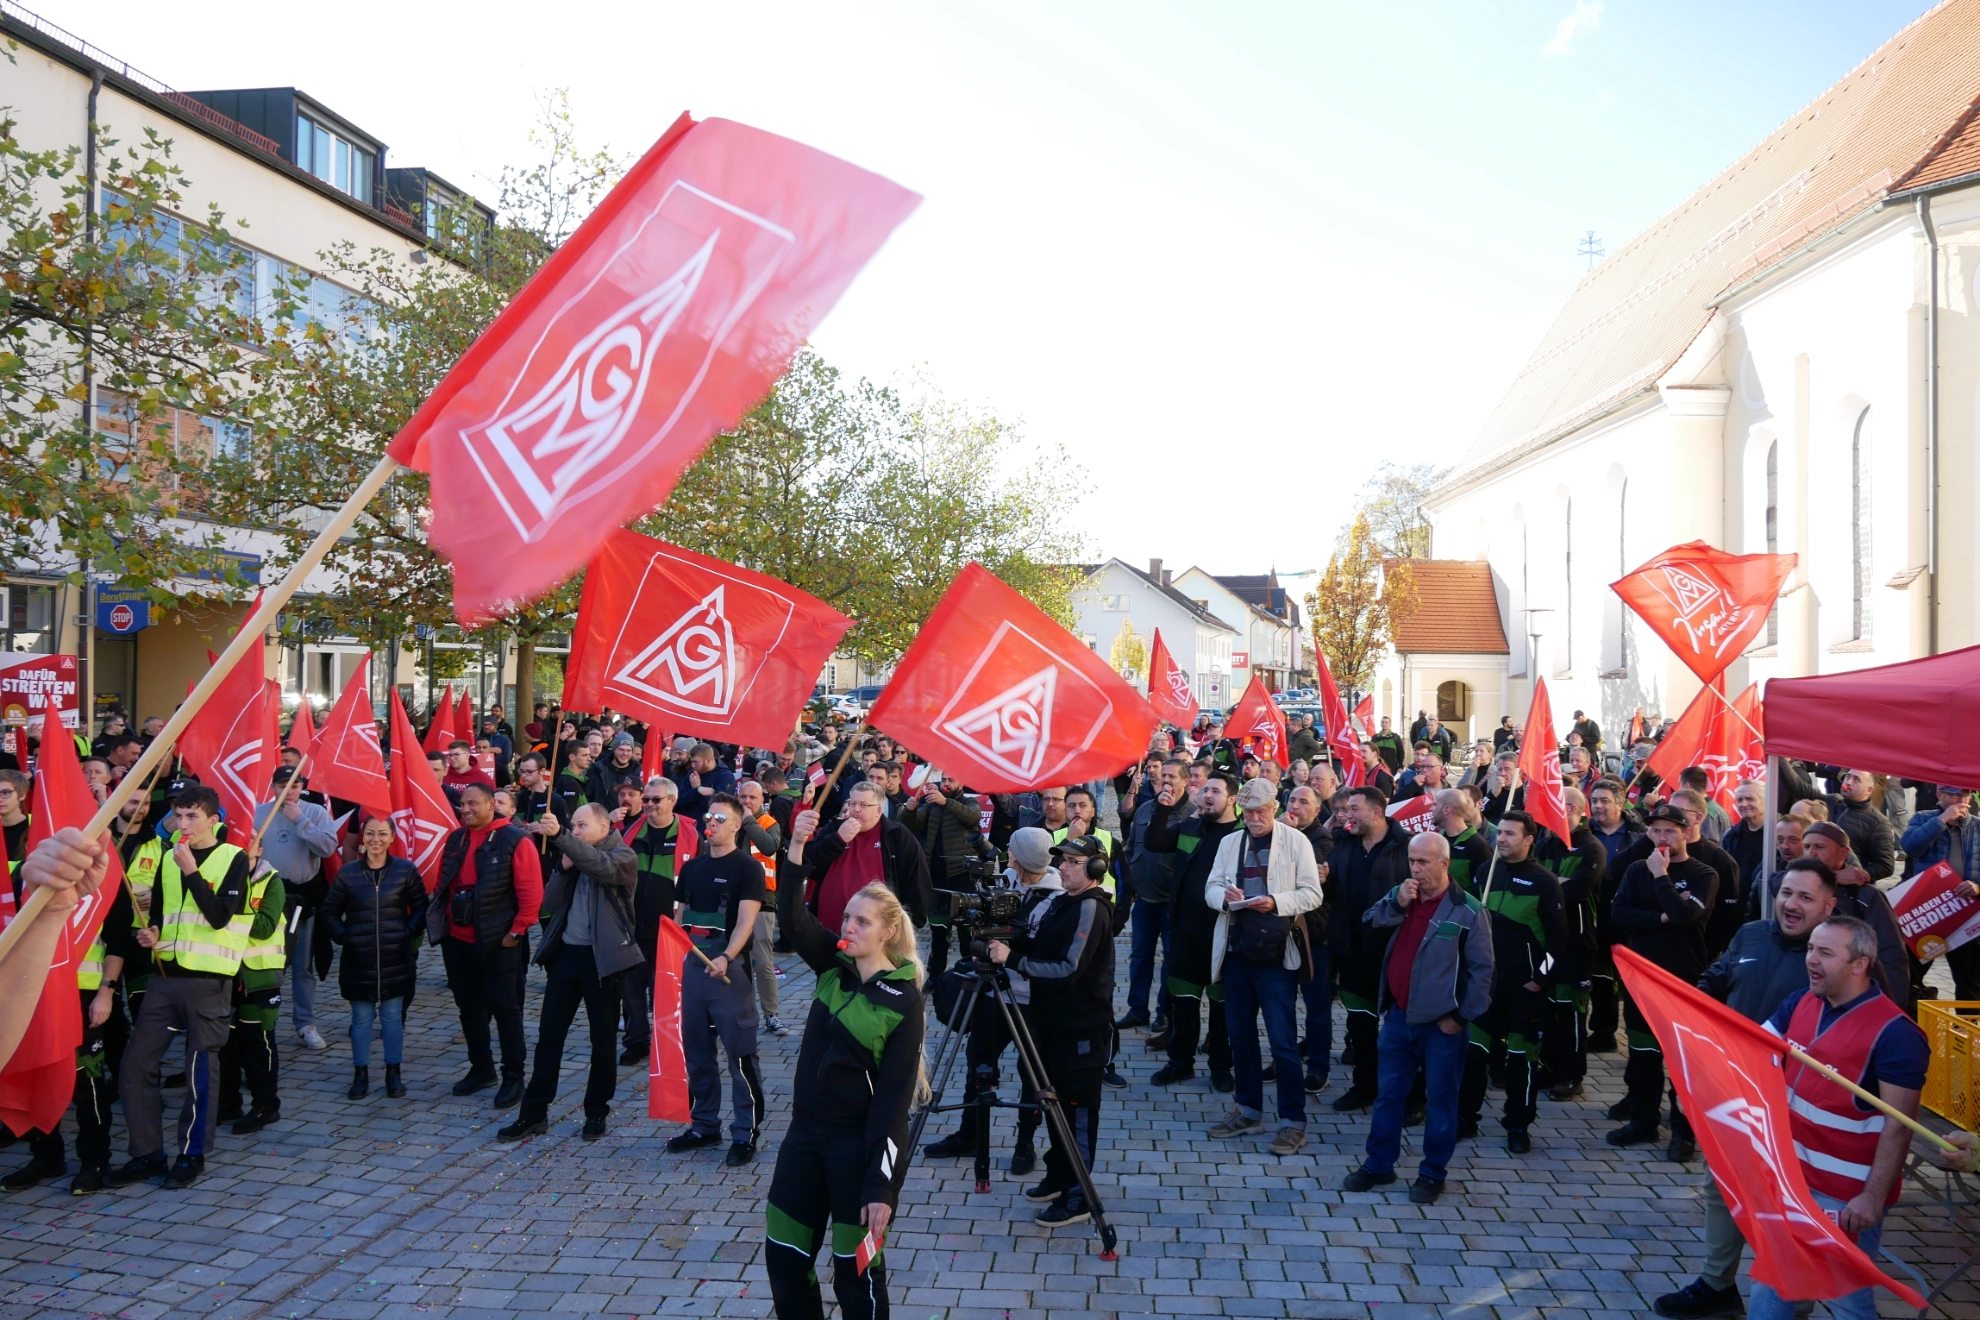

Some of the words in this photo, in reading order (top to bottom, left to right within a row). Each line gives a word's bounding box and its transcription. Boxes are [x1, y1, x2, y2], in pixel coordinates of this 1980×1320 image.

[112, 612, 131, 623] STOP
[19, 669, 57, 681] DAFÜR
[2, 678, 76, 695] STREITEN
[1399, 818, 1409, 827] ES
[1409, 815, 1421, 825] IST
[1911, 896, 1942, 918] HABEN
[1939, 889, 1954, 904] ES
[876, 980, 903, 996] FENDT
